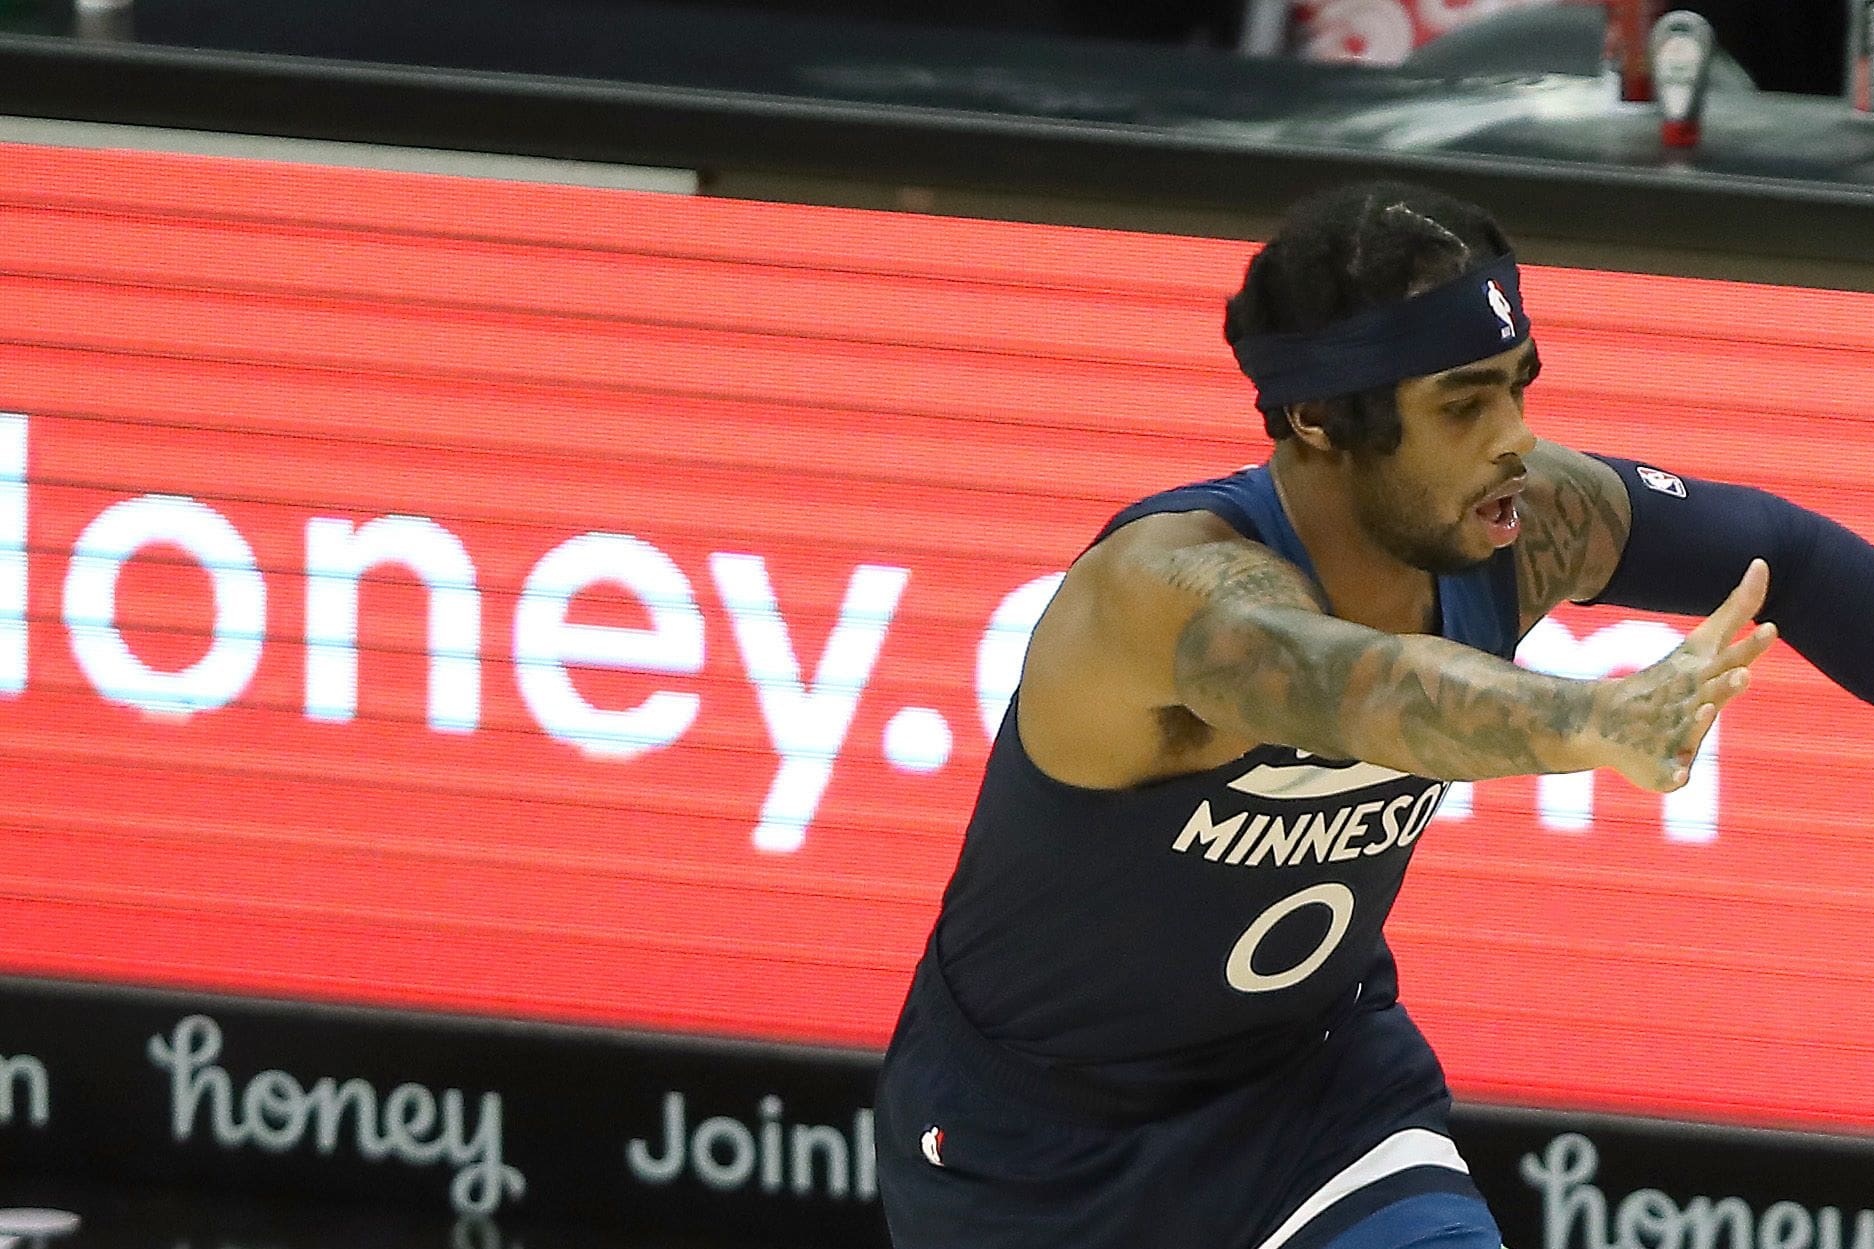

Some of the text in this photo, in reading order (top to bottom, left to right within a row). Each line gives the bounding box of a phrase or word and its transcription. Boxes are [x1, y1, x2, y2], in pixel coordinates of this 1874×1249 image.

[1171, 780, 1448, 868] MINNESO
[1225, 881, 1355, 993] 0
[146, 1013, 527, 1216] honey
